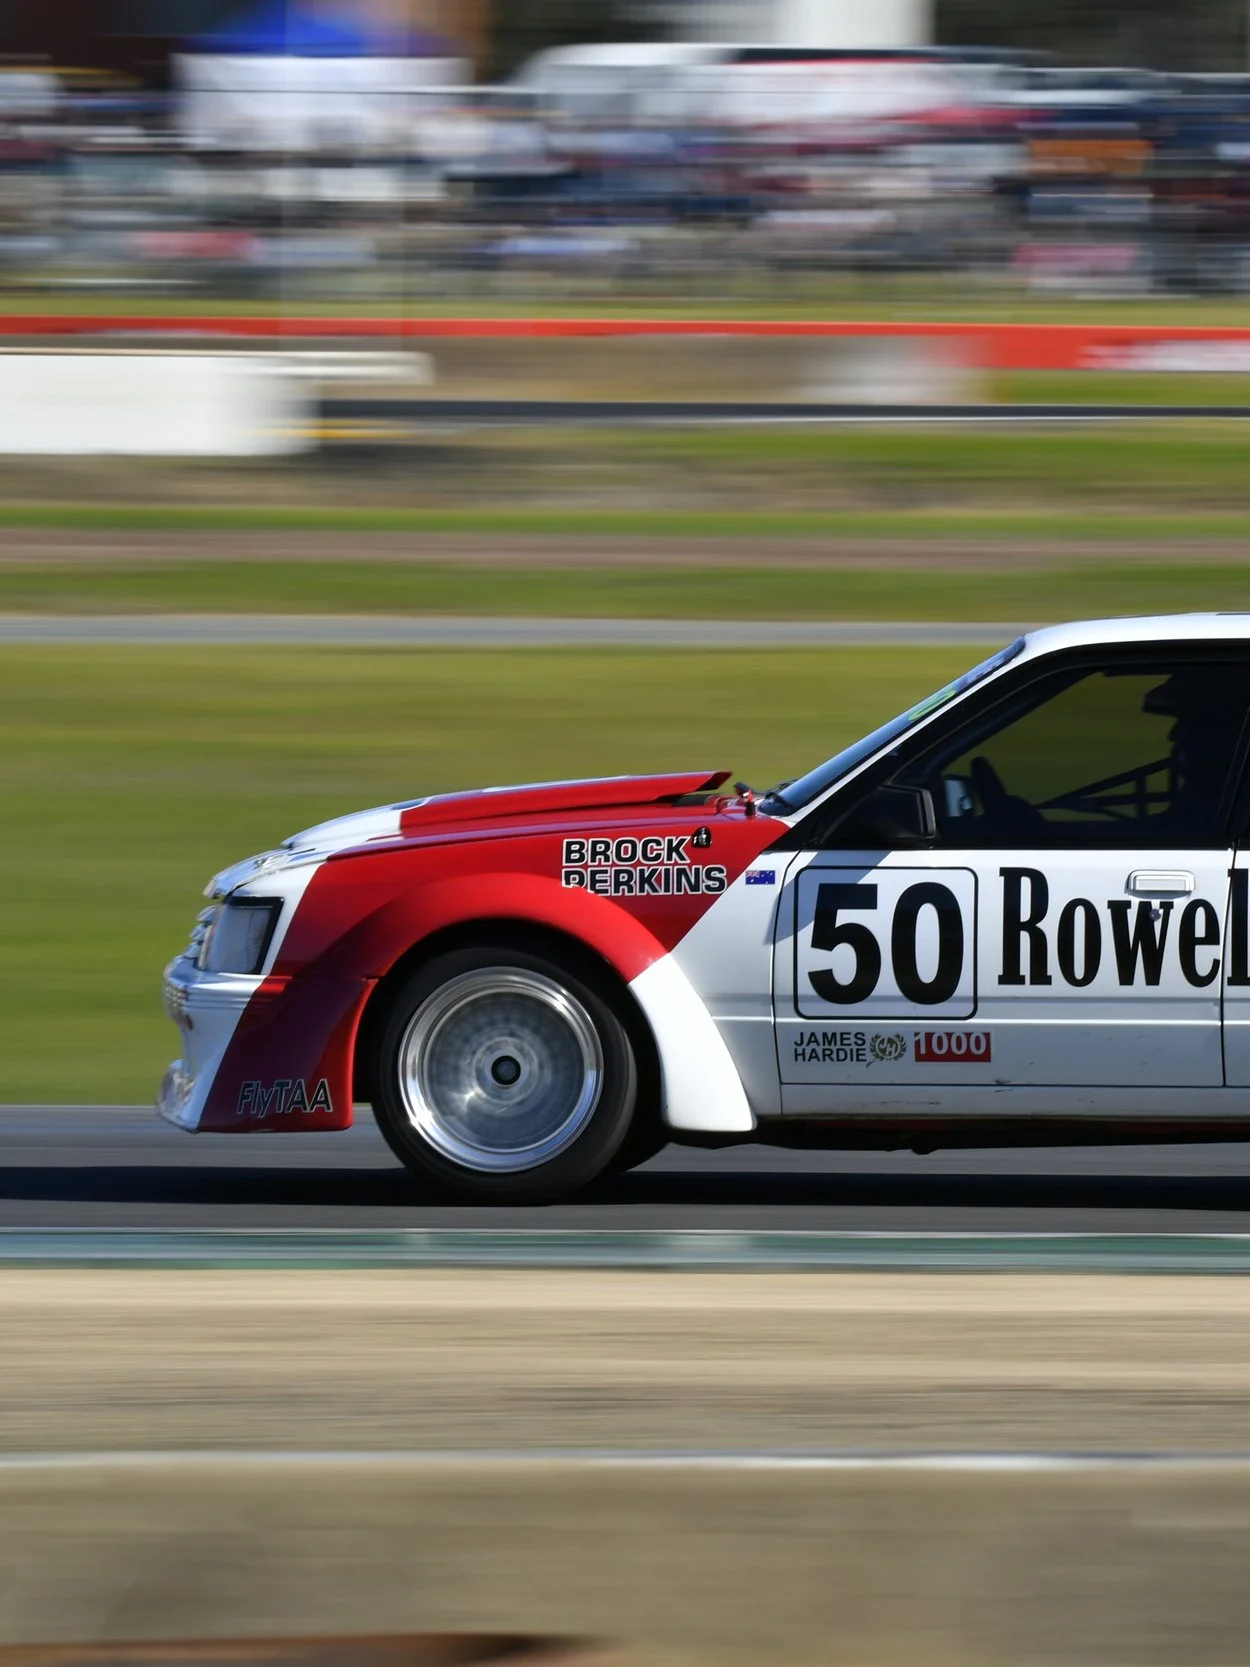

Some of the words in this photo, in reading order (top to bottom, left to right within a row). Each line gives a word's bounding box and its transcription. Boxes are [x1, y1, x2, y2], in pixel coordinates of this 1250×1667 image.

[562, 837, 691, 866] BROCK
[562, 865, 727, 896] PERKINS
[808, 882, 964, 1005] 50
[794, 1032, 866, 1047] JAMES
[914, 1031, 987, 1056] 1000
[794, 1049, 867, 1062] HARDIE
[236, 1078, 334, 1118] FlyTAA
